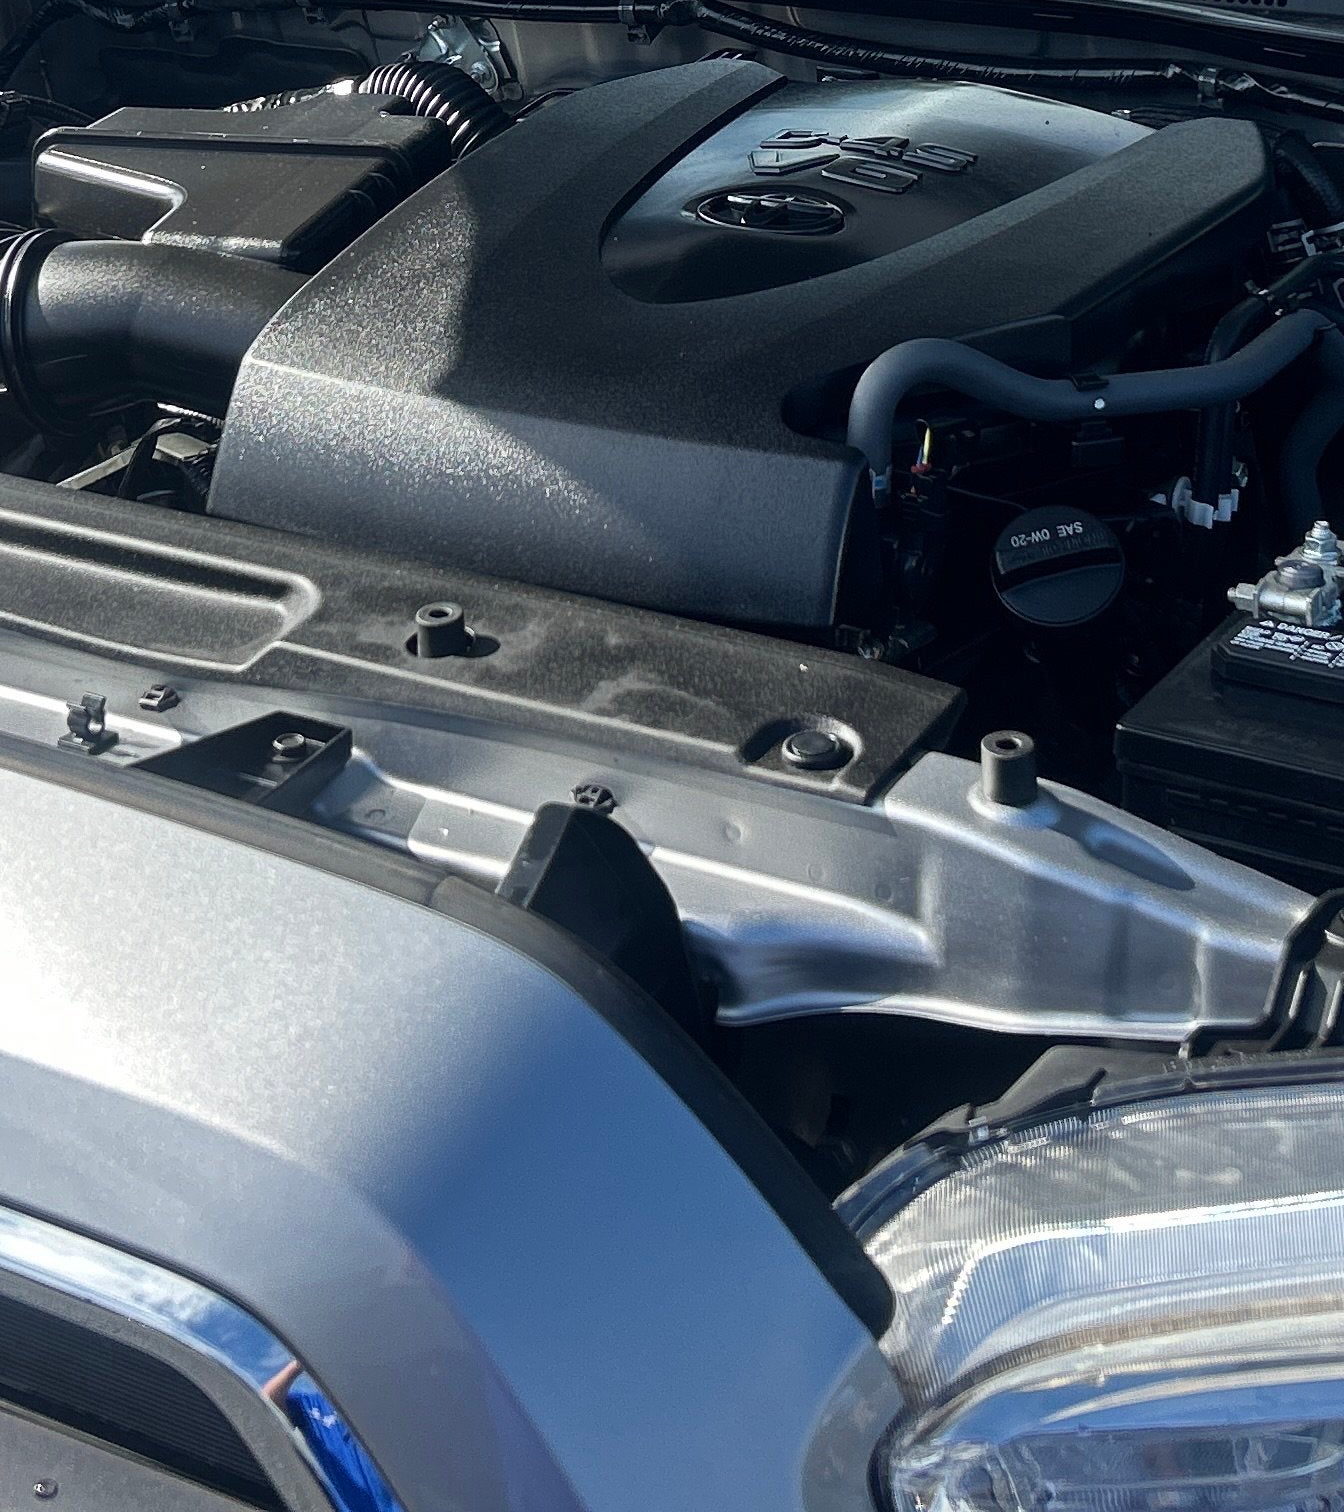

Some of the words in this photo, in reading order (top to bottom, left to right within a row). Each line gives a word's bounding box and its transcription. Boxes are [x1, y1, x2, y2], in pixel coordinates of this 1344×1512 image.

[1010, 528, 1051, 548] 0W-20
[1056, 521, 1083, 538] SAE
[1277, 622, 1331, 639] DANGER
